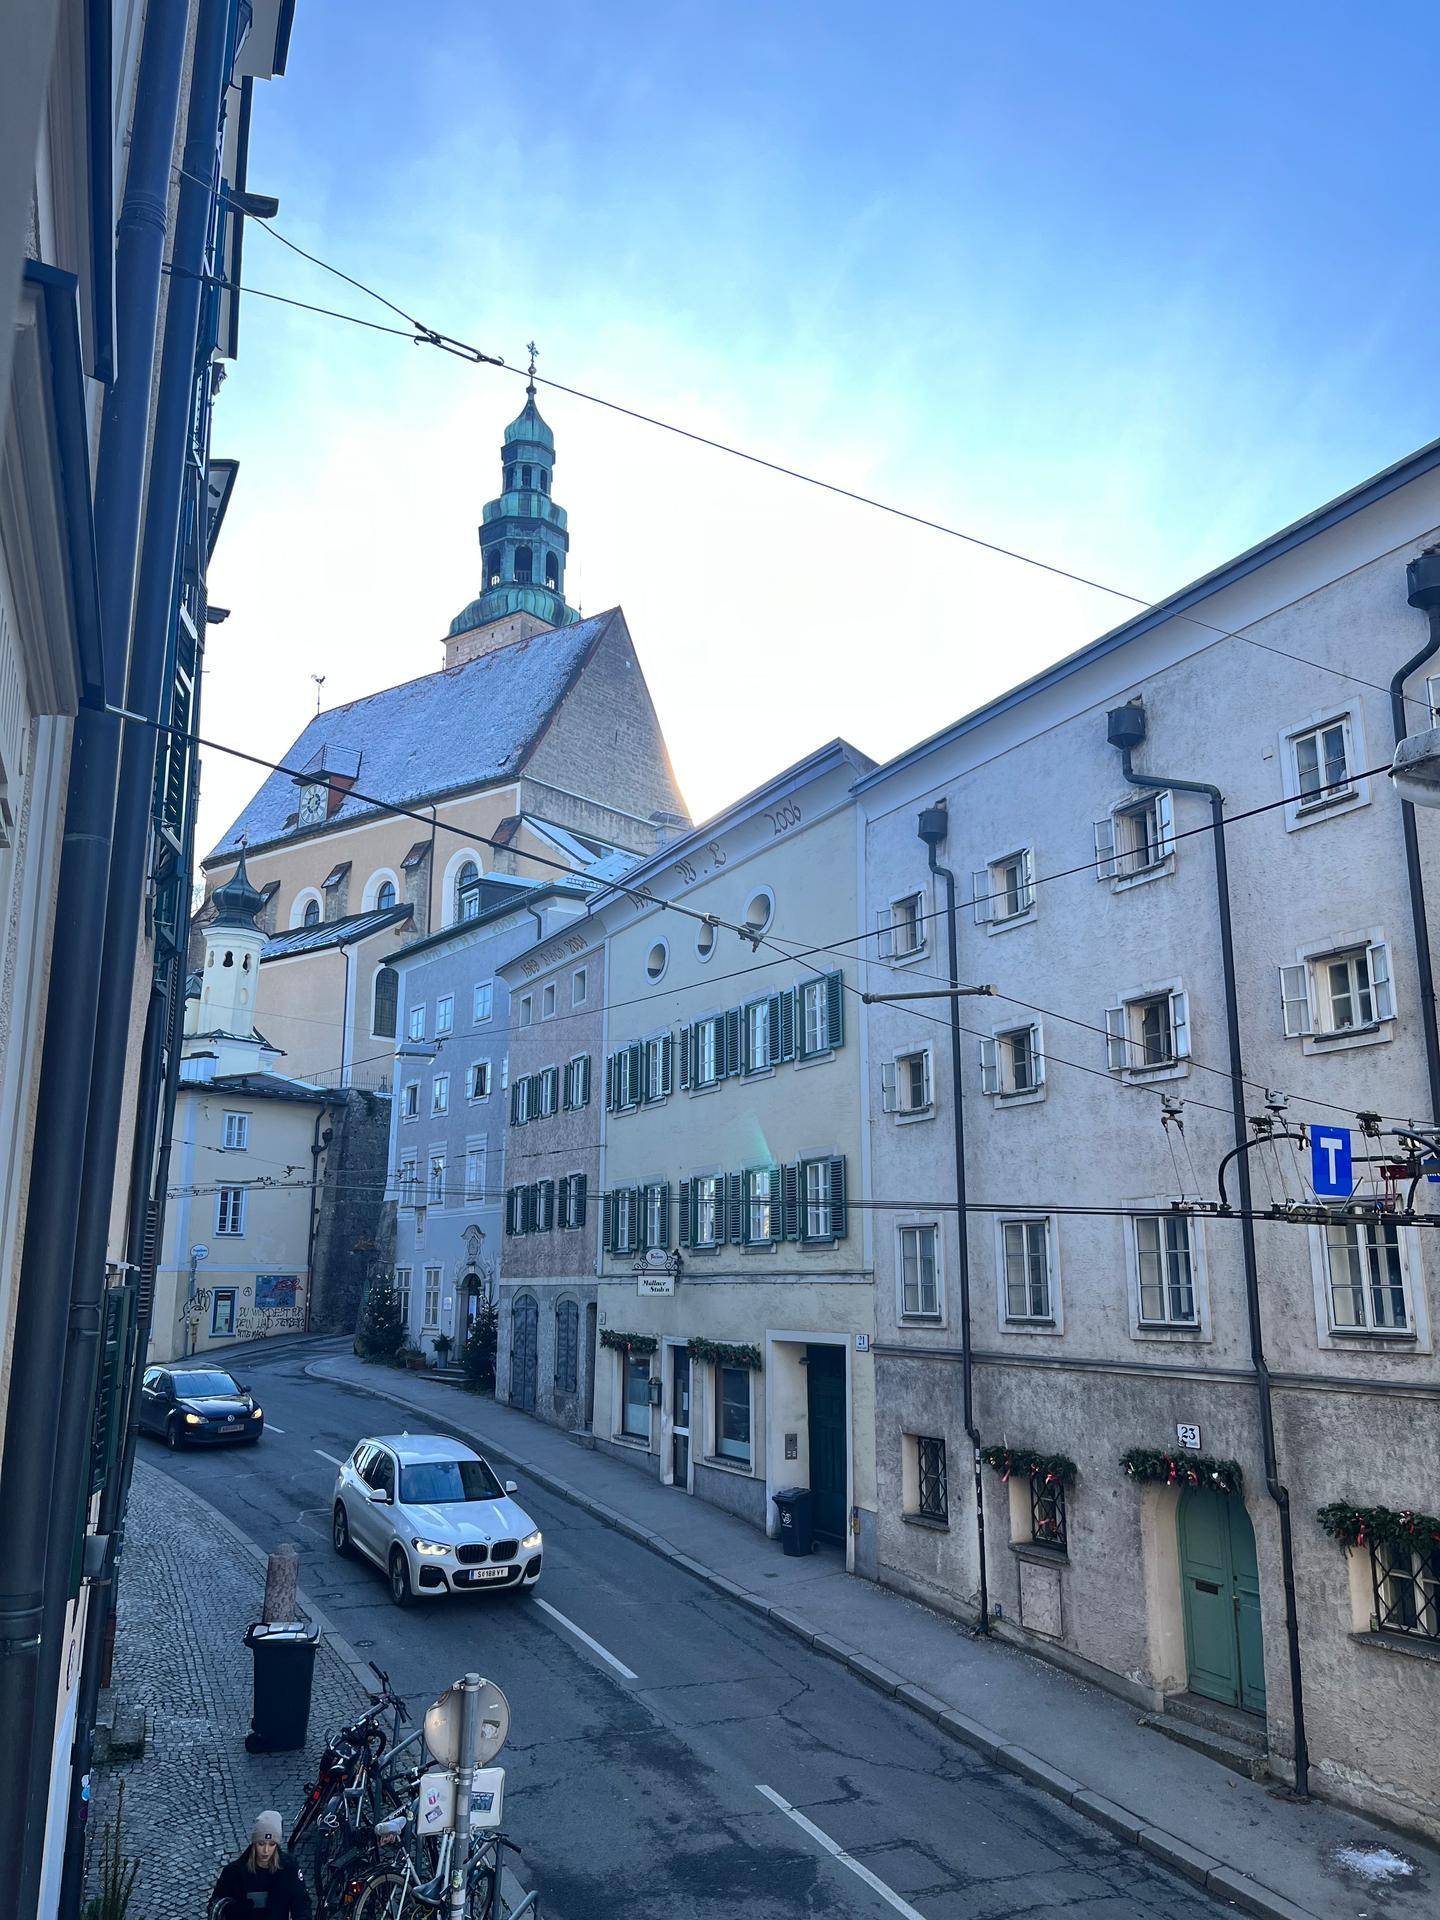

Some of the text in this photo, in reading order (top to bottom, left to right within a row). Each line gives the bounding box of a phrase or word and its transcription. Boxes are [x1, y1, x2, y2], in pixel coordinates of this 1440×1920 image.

[764, 799, 802, 835] 2006
[1320, 1137, 1342, 1184] T
[857, 1335, 866, 1346] 21
[1180, 1426, 1196, 1441] 23
